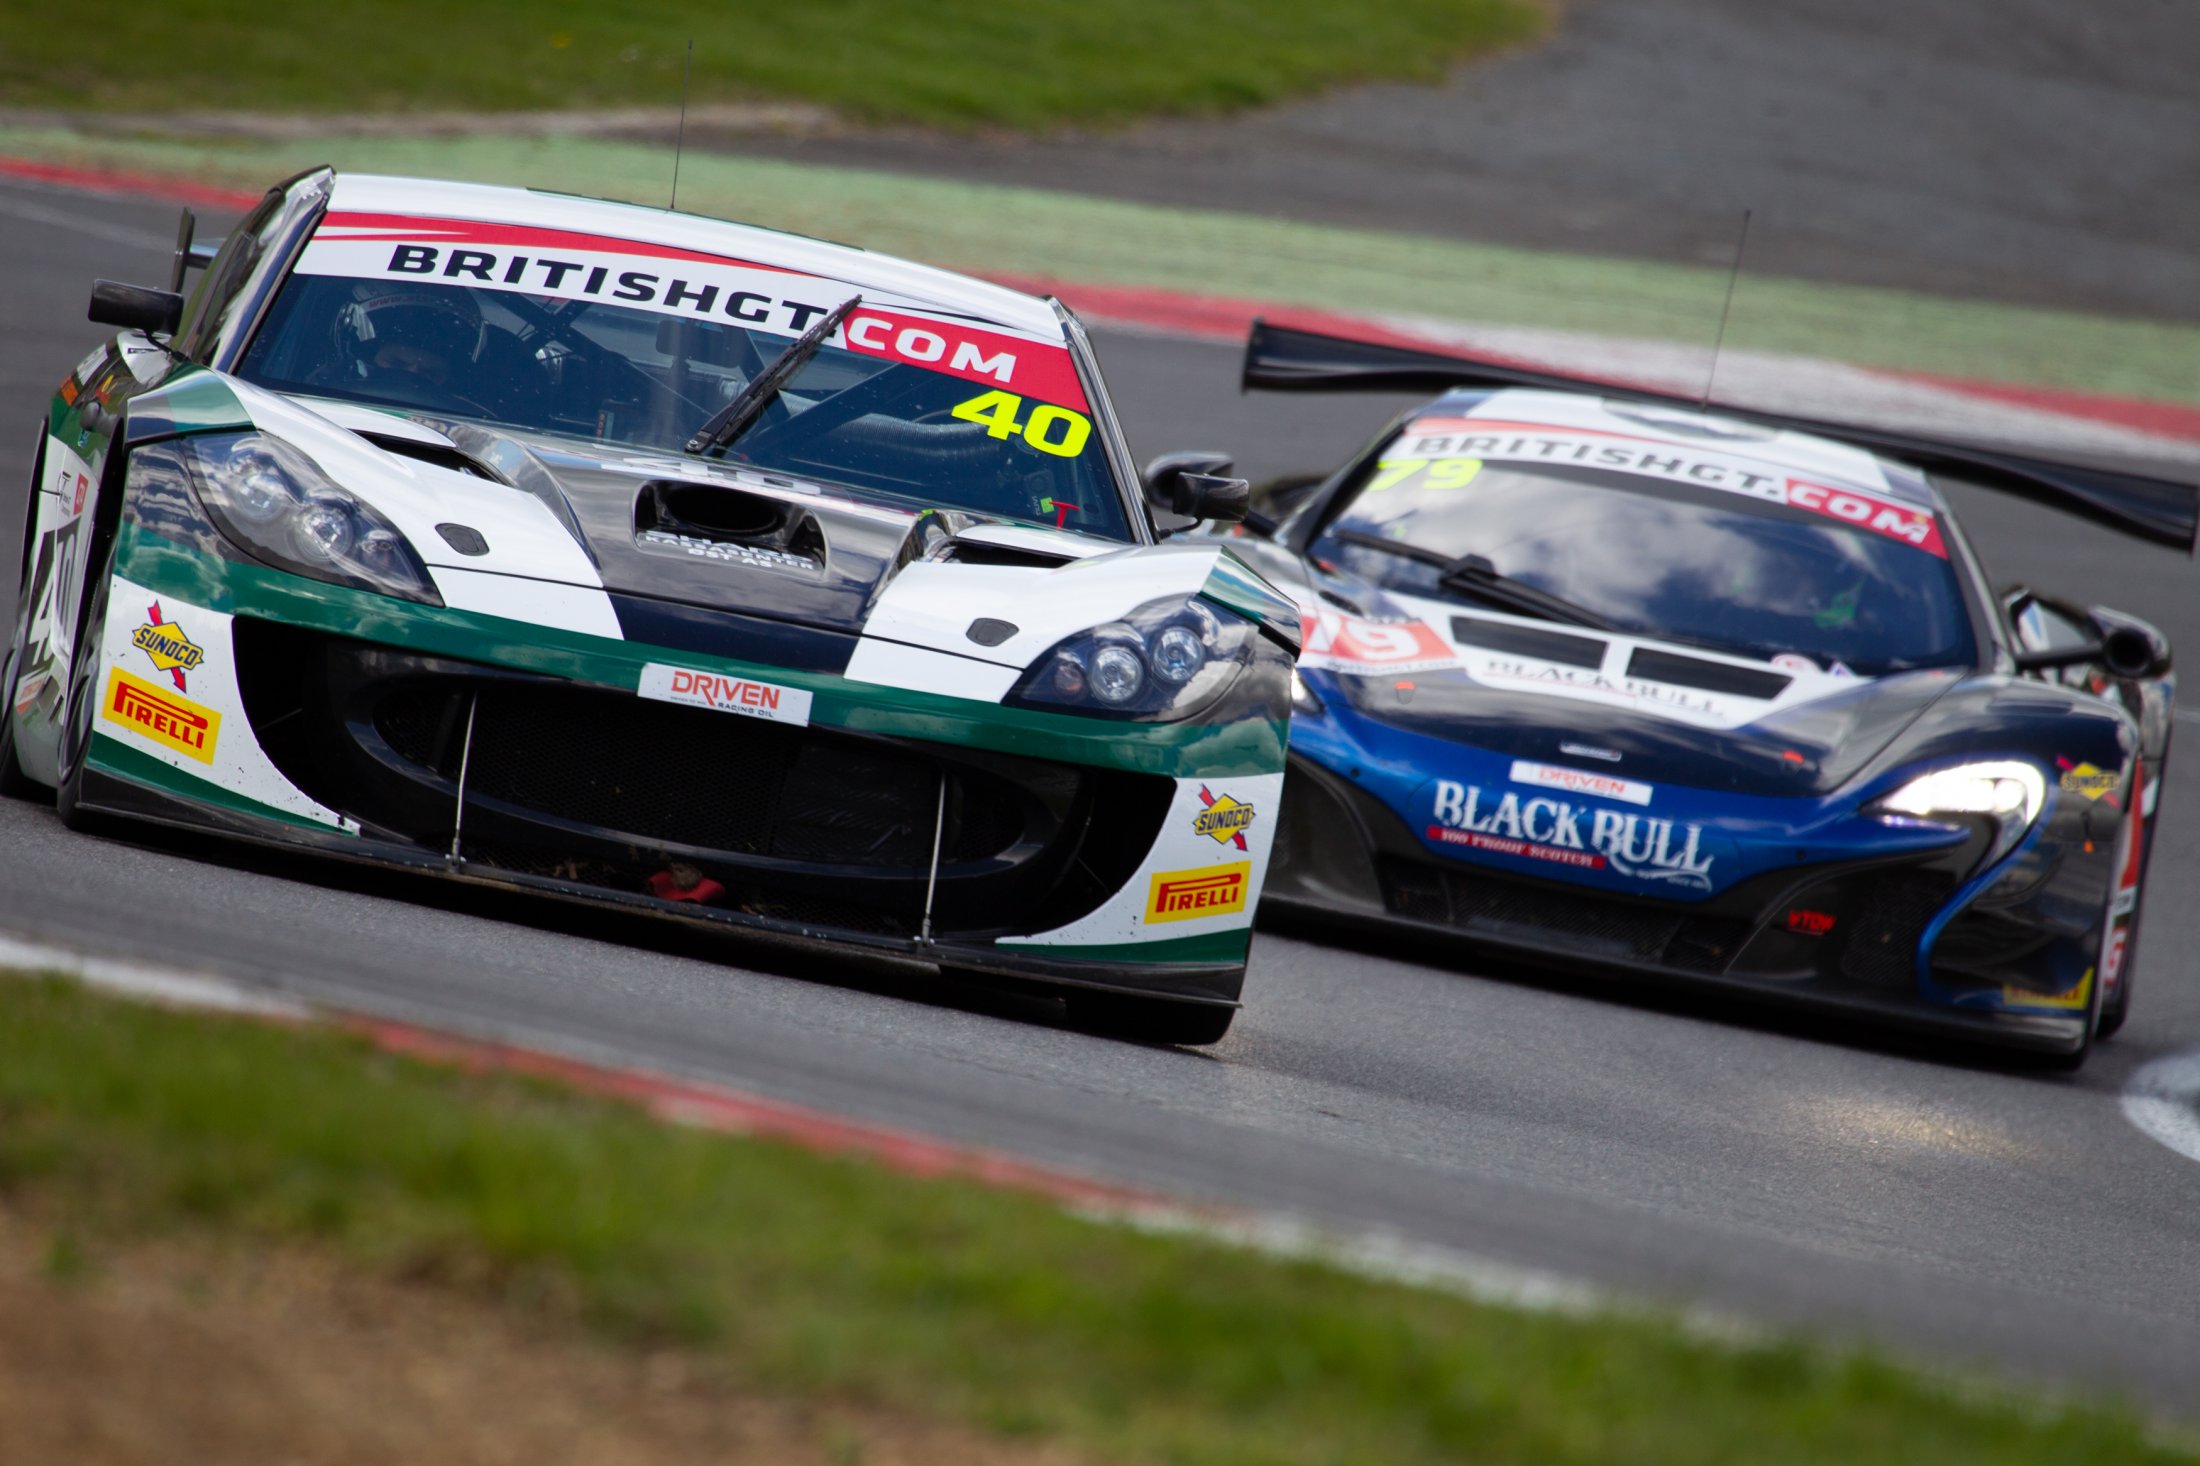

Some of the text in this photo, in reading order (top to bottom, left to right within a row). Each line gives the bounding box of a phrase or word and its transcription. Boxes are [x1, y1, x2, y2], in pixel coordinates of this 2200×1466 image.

[387, 244, 1017, 383] BRITISHGTCOM
[951, 390, 1092, 458] 40
[1369, 457, 1483, 491] 79
[1412, 437, 1931, 545] BRITISHGT.COM
[136, 627, 199, 667] SUNOCO
[671, 671, 780, 710] DRIVEN
[1488, 661, 1614, 690] BLACK
[113, 680, 208, 750] PIRELLI
[717, 702, 774, 718] RACING OIL
[1538, 766, 1626, 795] DRIVEN
[1198, 807, 1250, 832] SUNOCO
[1432, 778, 1716, 892] BLACK BULL
[1155, 873, 1242, 914] PIRELLI
